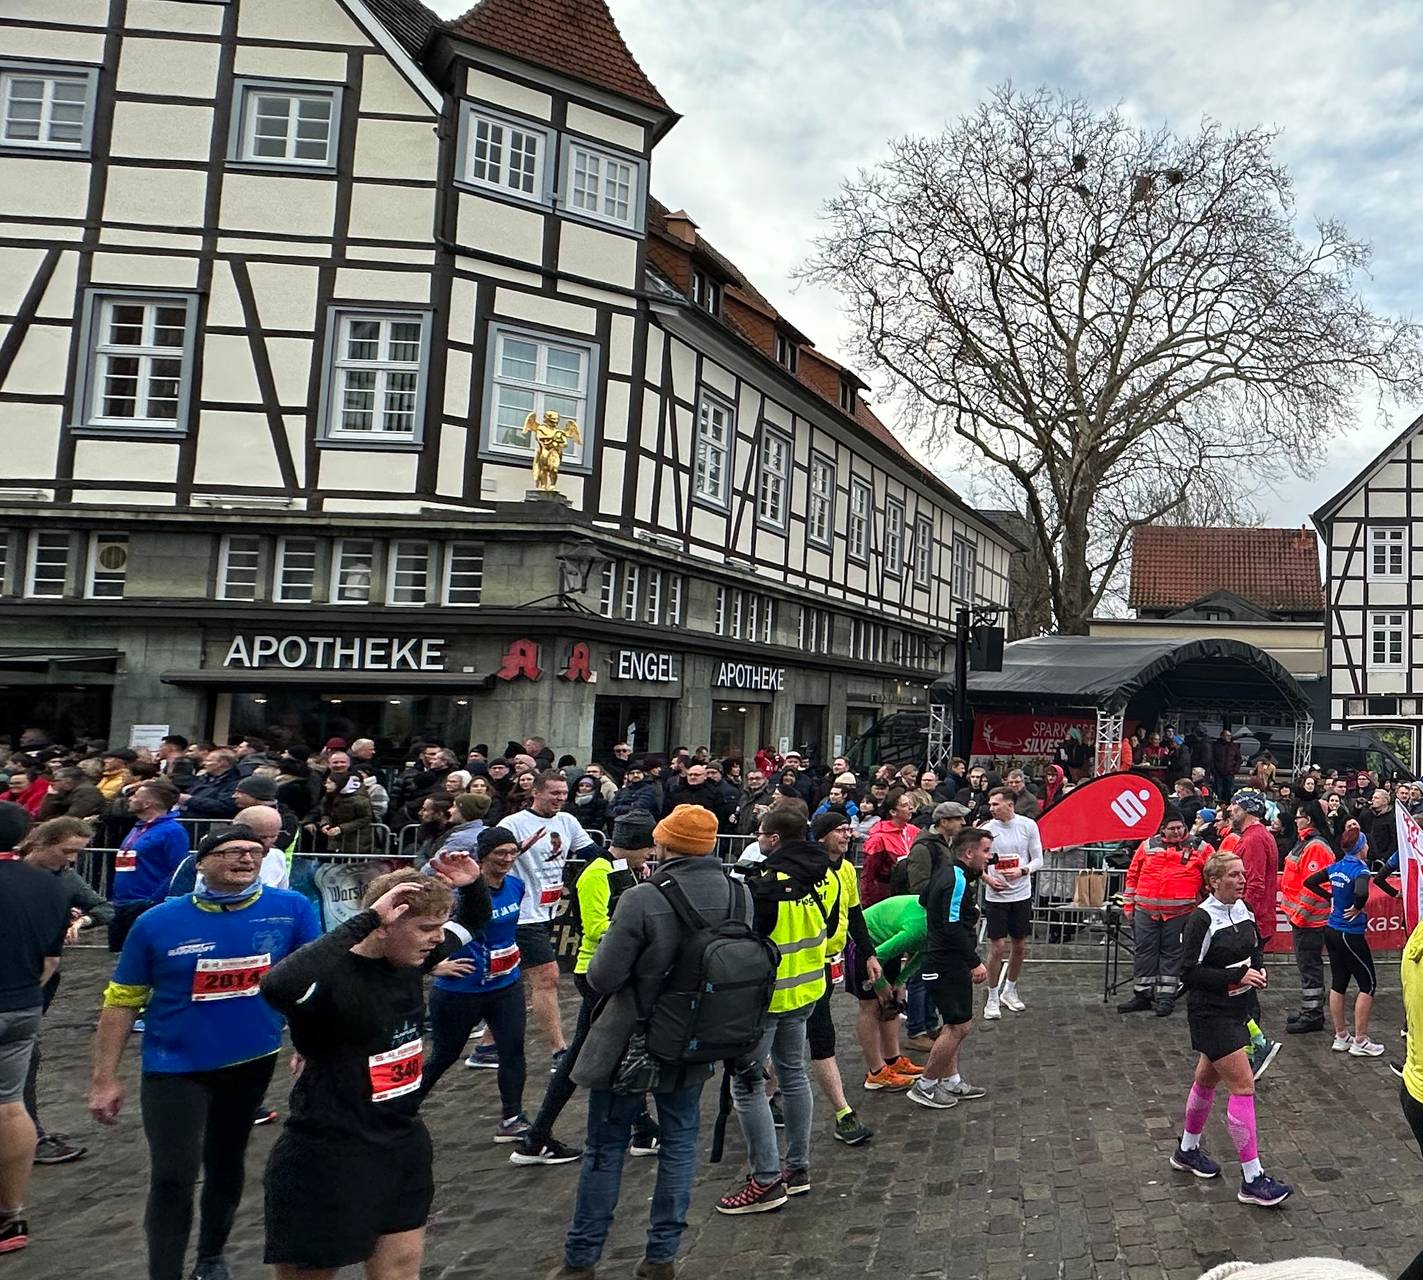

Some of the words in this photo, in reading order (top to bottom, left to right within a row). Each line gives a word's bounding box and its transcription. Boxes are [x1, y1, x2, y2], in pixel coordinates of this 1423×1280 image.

[223, 635, 445, 670] APOTHEKE
[618, 650, 678, 682] ENGEL
[717, 662, 785, 690] APOTHEKE
